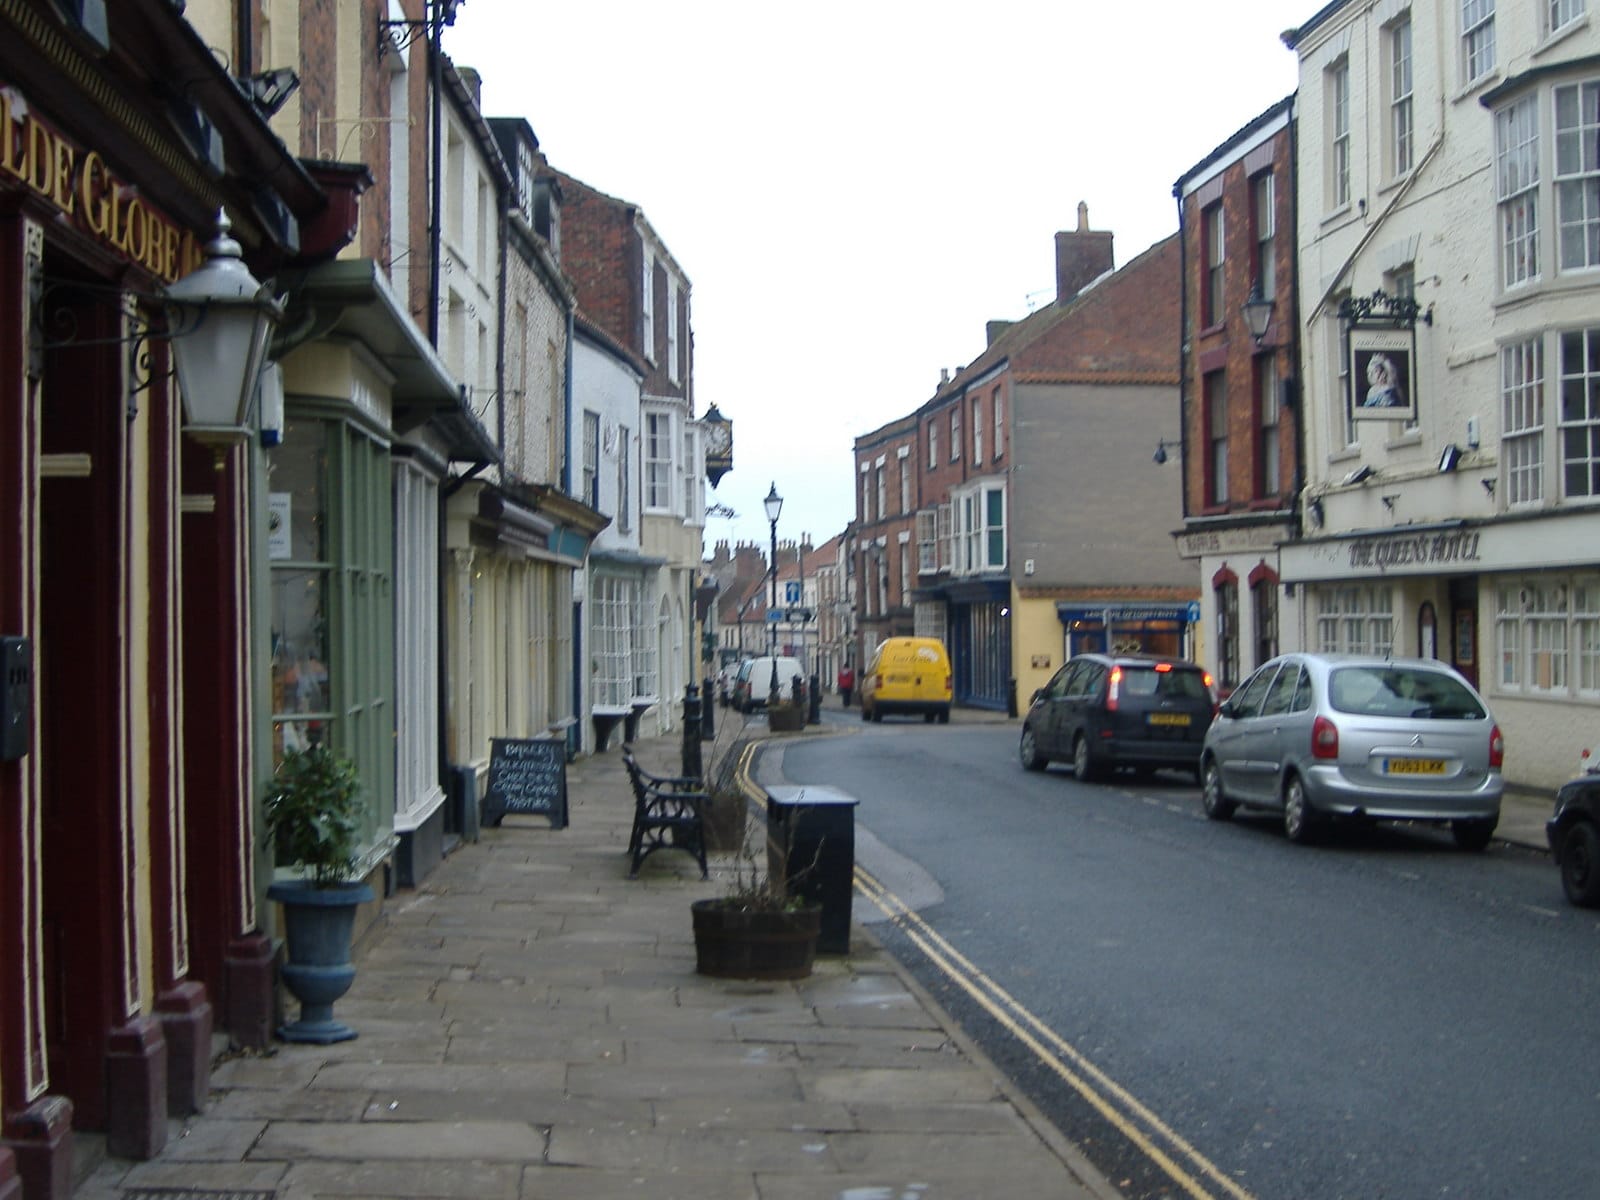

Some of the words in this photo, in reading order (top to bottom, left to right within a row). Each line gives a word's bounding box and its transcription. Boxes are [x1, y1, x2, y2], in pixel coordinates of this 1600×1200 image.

[82, 150, 180, 285] GLOBE
[1348, 541, 1377, 568] THE
[1428, 530, 1481, 562] HOTEL
